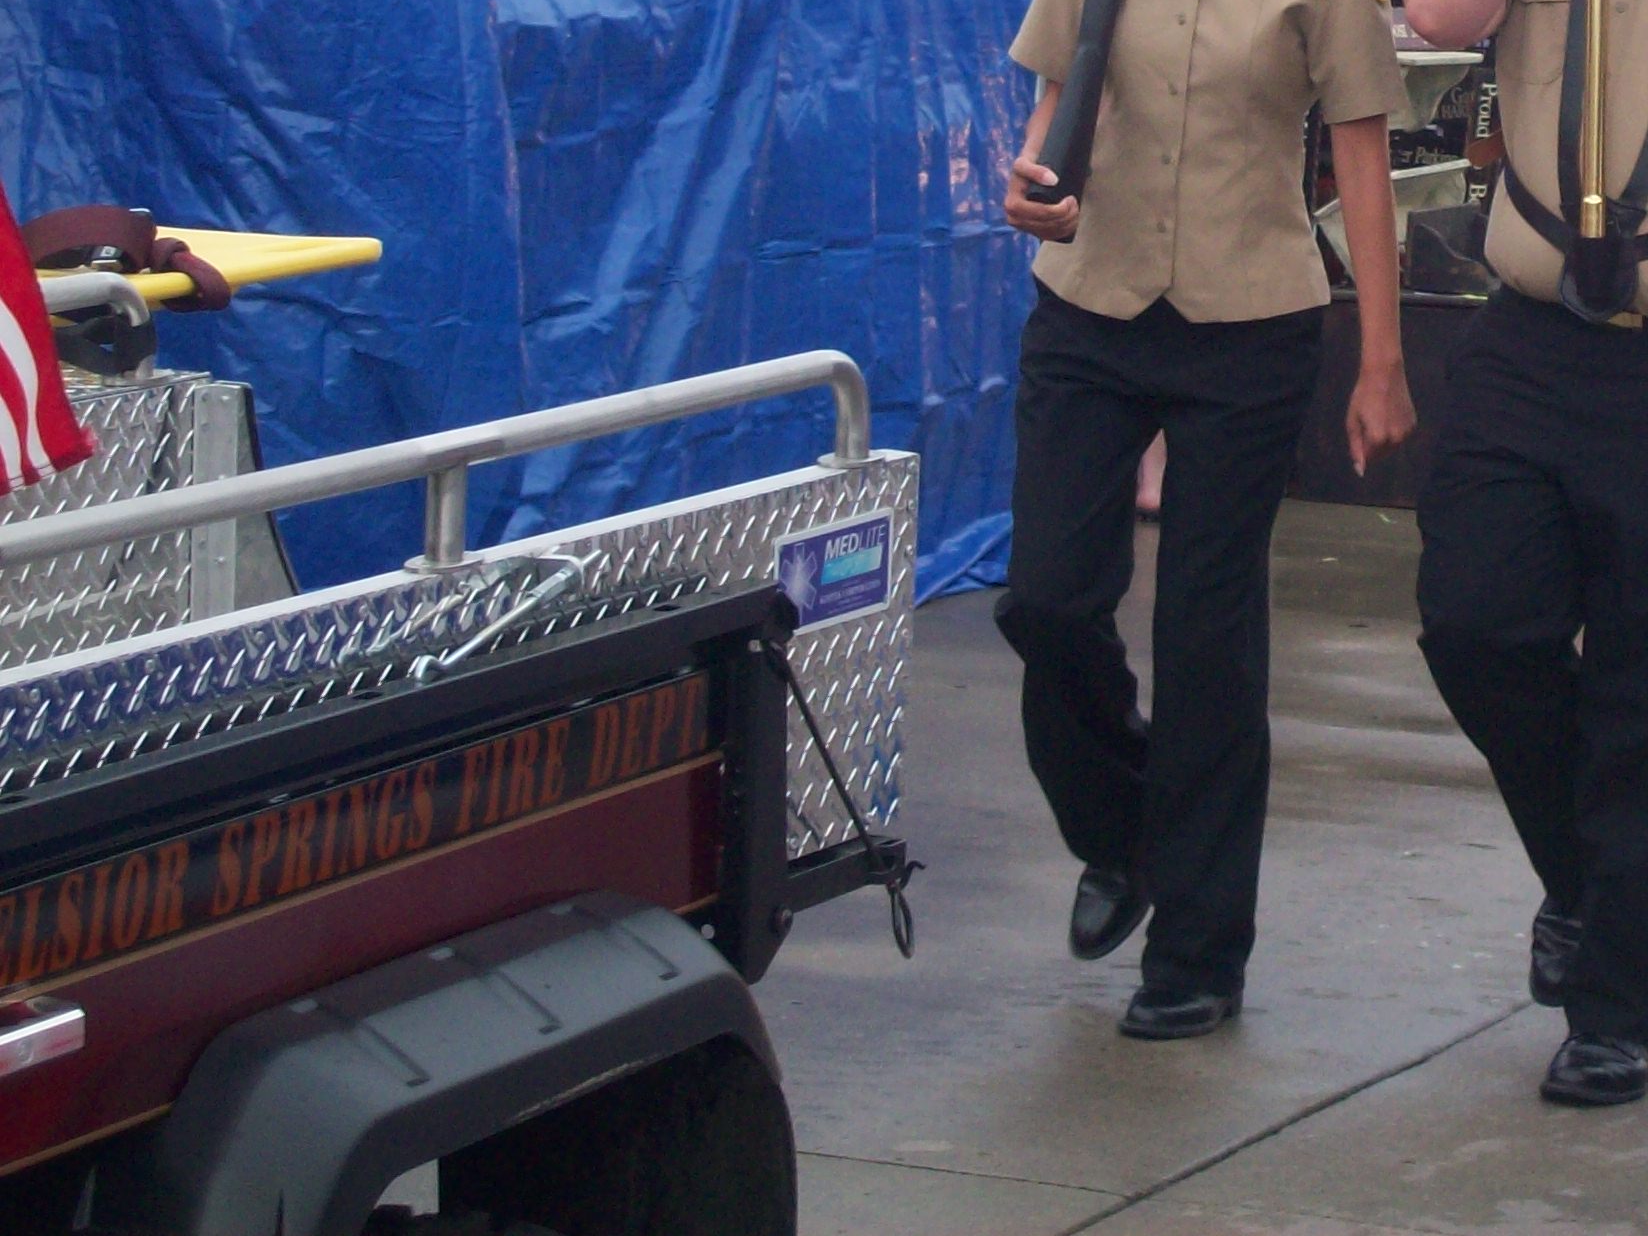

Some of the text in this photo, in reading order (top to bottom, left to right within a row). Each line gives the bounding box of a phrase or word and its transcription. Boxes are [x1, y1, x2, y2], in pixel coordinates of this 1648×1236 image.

[1476, 81, 1500, 139] Proud
[824, 524, 887, 562] MEDLITE
[211, 757, 437, 916] SPRINGS
[455, 717, 571, 834] FIRE
